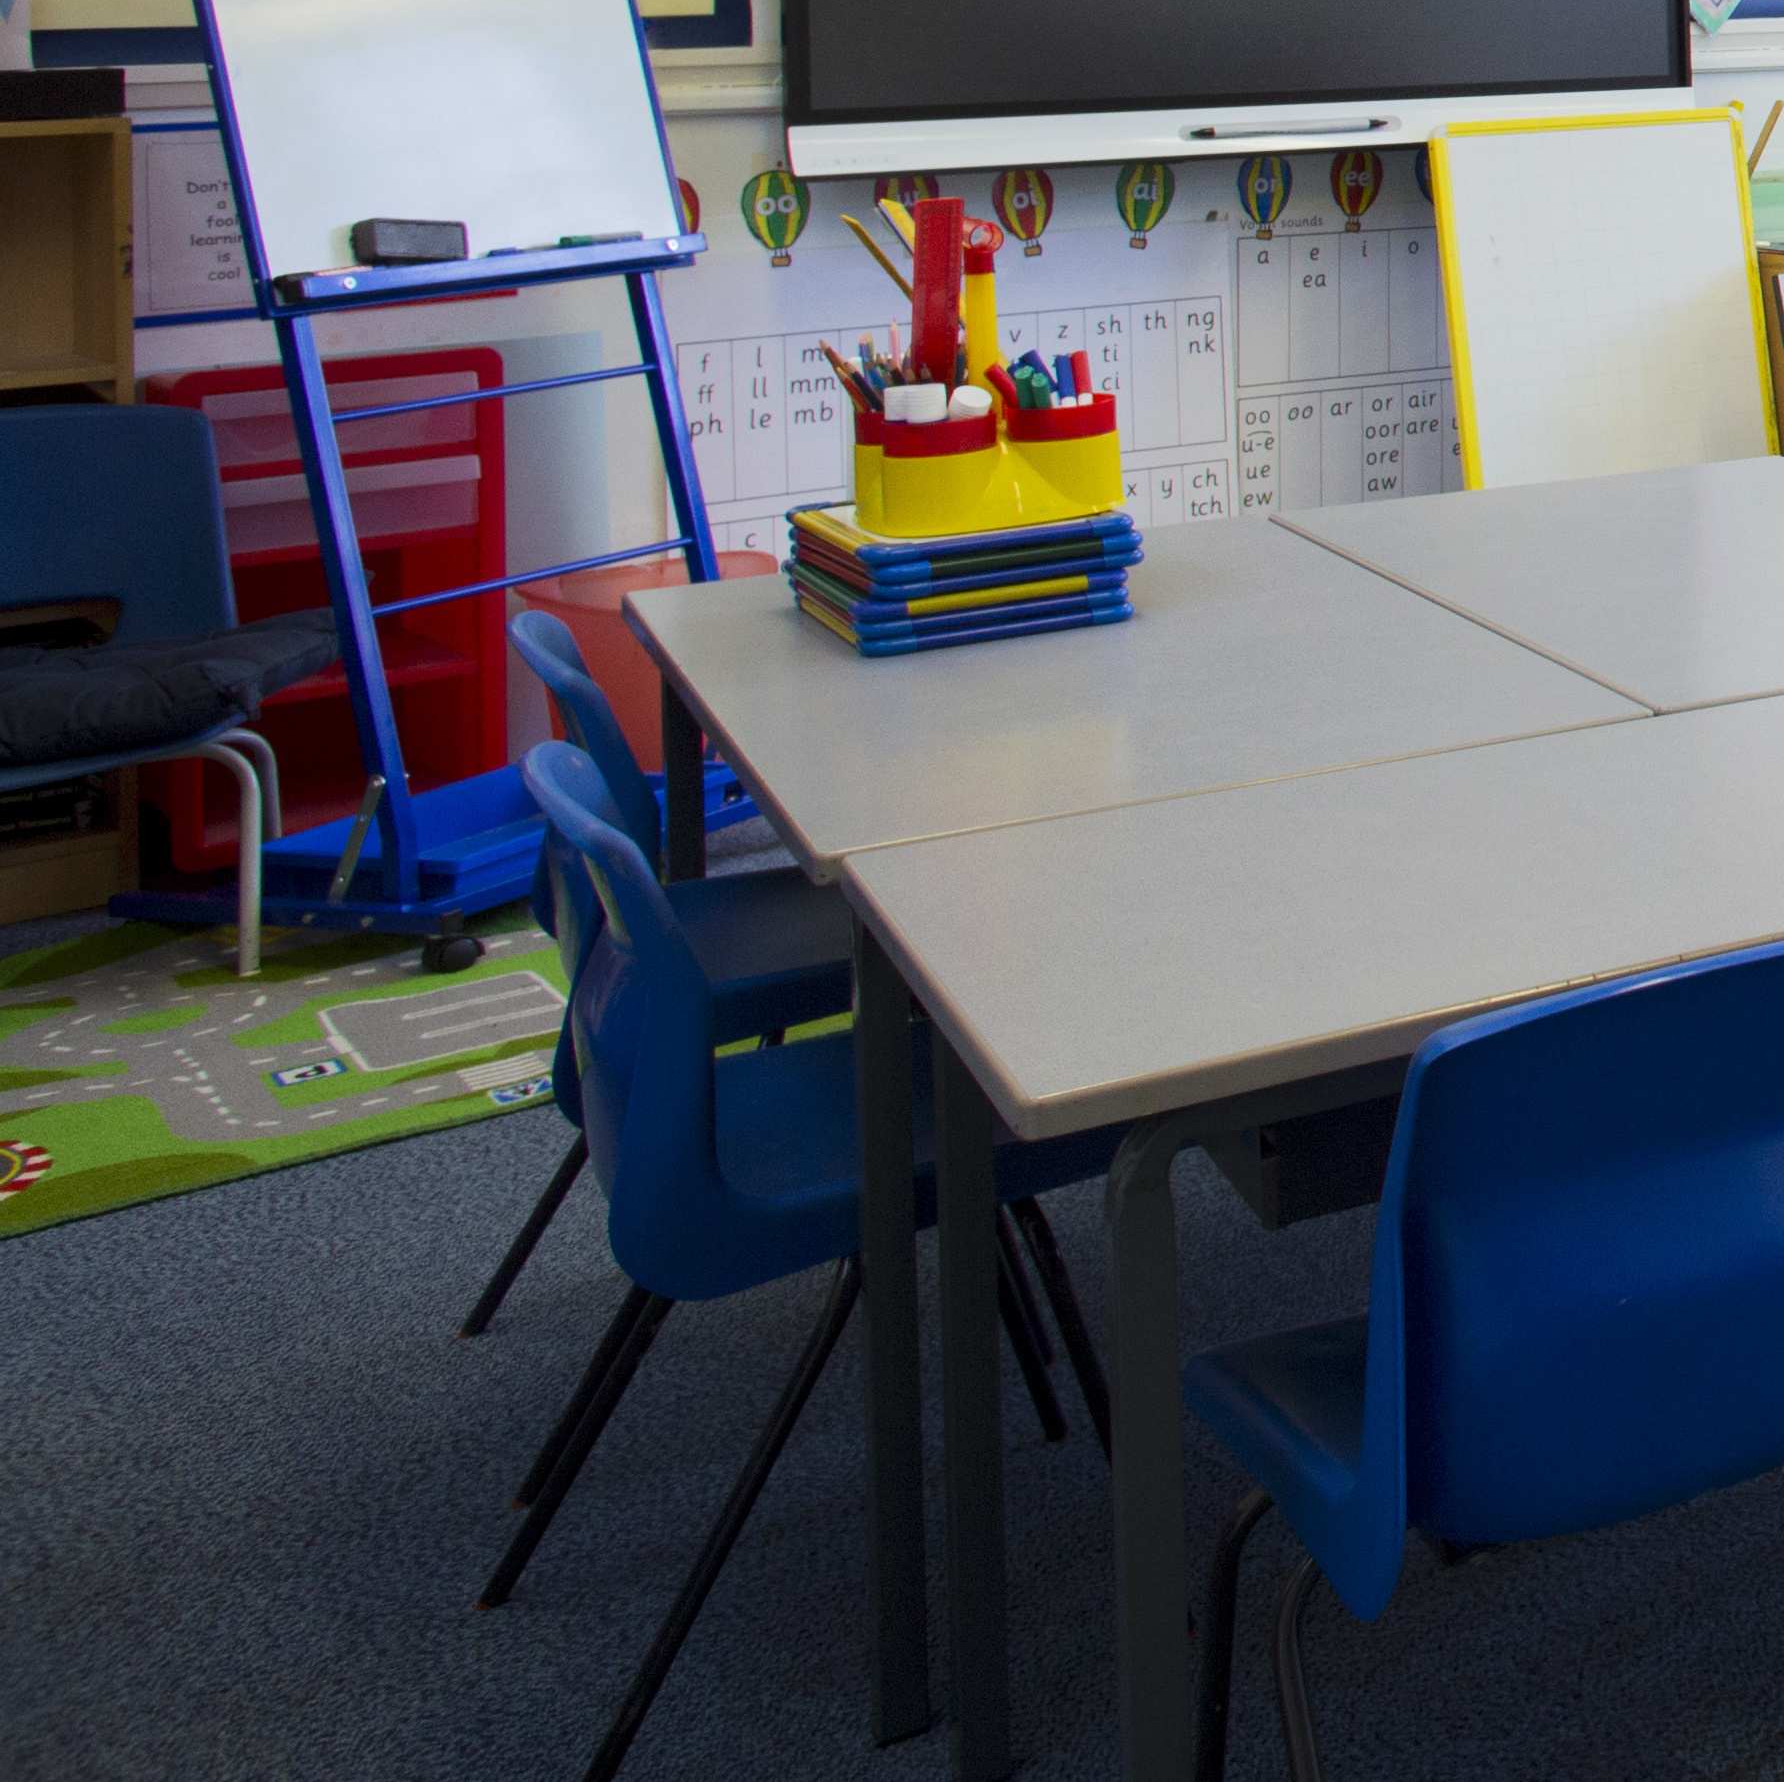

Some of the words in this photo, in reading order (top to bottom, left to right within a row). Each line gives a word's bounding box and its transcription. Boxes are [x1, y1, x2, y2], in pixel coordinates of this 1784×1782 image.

[186, 181, 229, 194] Don't
[1253, 175, 1283, 194] or
[1343, 169, 1371, 188] ee
[1010, 183, 1039, 210] oi
[1133, 178, 1160, 203] ai
[217, 200, 227, 209] a
[755, 193, 798, 216] oo
[1280, 214, 1324, 230] sounds
[217, 253, 231, 262] is
[1257, 249, 1270, 265] a
[1309, 246, 1321, 262] e
[1361, 240, 1367, 258] i
[1408, 240, 1419, 255] o
[208, 266, 241, 281] cool
[1302, 272, 1327, 289] ea
[1009, 328, 1022, 343] v
[1057, 324, 1069, 339] z
[1097, 313, 1122, 335] sh
[1143, 309, 1168, 331] th
[1187, 309, 1215, 330] ng
[1103, 342, 1119, 363] ti
[1188, 334, 1217, 354] nk
[700, 352, 711, 372] f
[697, 382, 715, 404] ff
[752, 376, 768, 398] ll
[790, 375, 837, 395] mm
[1102, 370, 1120, 391] ci
[1245, 409, 1271, 425] oo
[1287, 405, 1314, 421] oo
[1330, 400, 1353, 417] ar
[1371, 395, 1393, 413] or
[1408, 390, 1437, 408] air
[689, 413, 723, 442] ph
[749, 408, 773, 430] le
[793, 401, 834, 425] mb
[1241, 437, 1275, 454] u-e
[1365, 423, 1400, 440] oor
[1406, 418, 1439, 435] are
[1246, 464, 1271, 481] ue
[1366, 449, 1399, 467] ore
[1126, 481, 1137, 497] x
[1161, 478, 1173, 498] y
[1192, 469, 1218, 489] ch
[1244, 490, 1273, 509] ew
[1367, 476, 1397, 493] aw
[1191, 496, 1223, 517] tch
[745, 532, 757, 548] c
